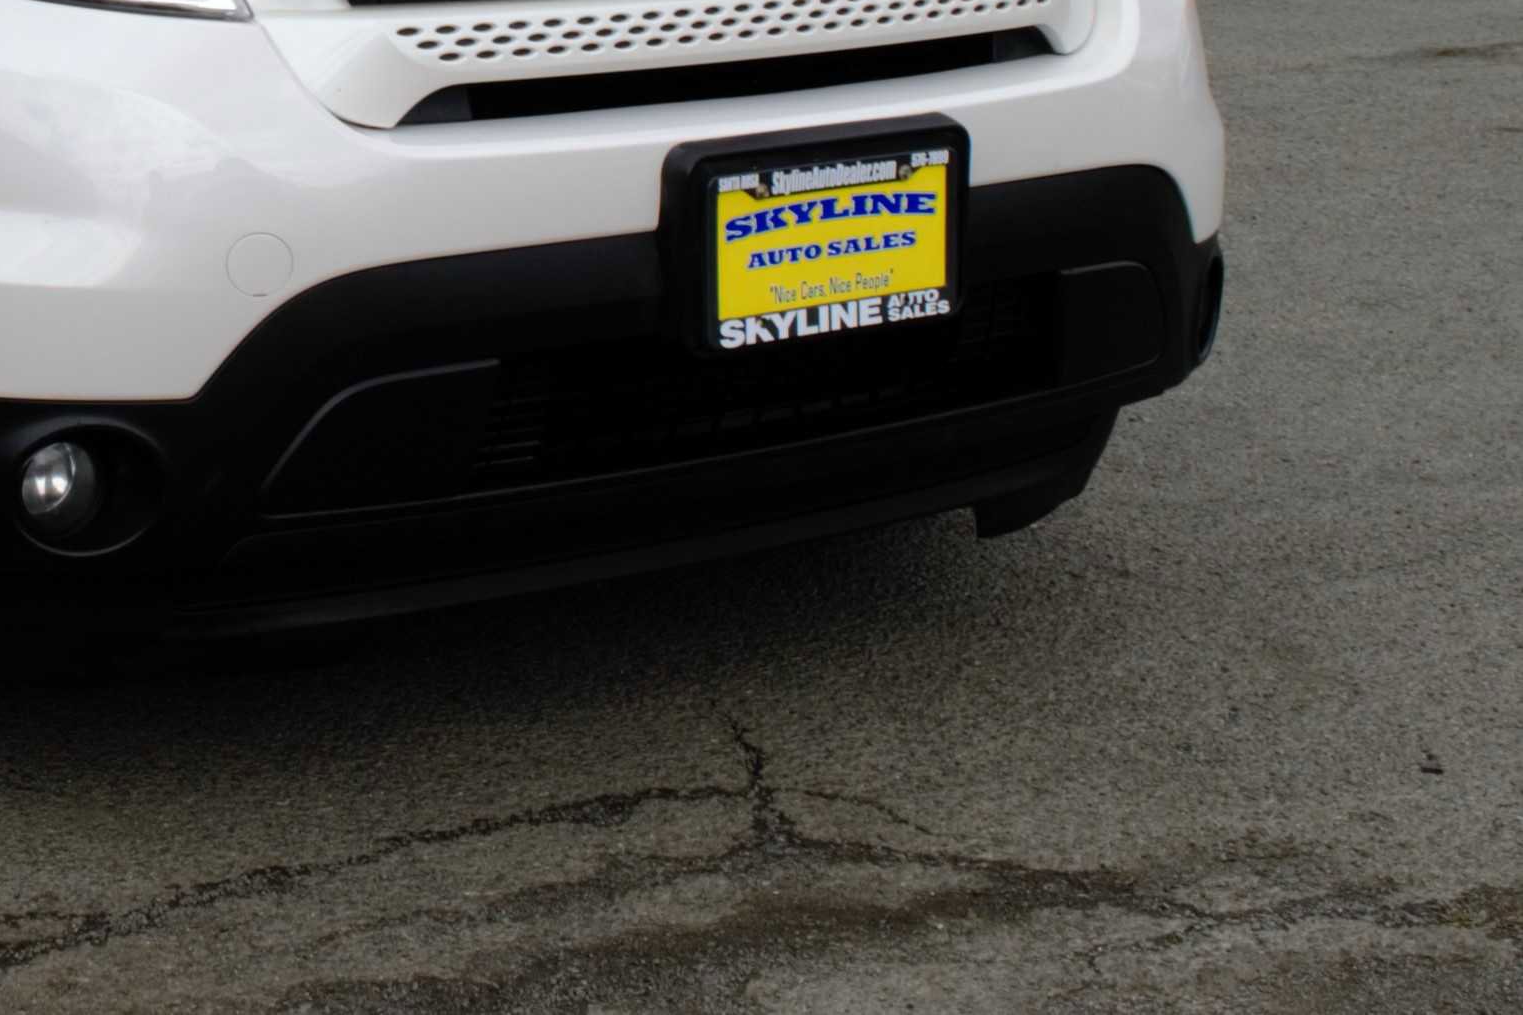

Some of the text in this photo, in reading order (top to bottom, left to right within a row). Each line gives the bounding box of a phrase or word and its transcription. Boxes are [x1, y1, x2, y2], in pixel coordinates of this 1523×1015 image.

[724, 191, 938, 242] SKYLINE
[747, 230, 917, 269] AUTO SALES
[829, 276, 852, 295] Nice
[887, 289, 939, 308] AUTO
[719, 297, 883, 348] SKYLINE
[887, 300, 951, 322] SALES
